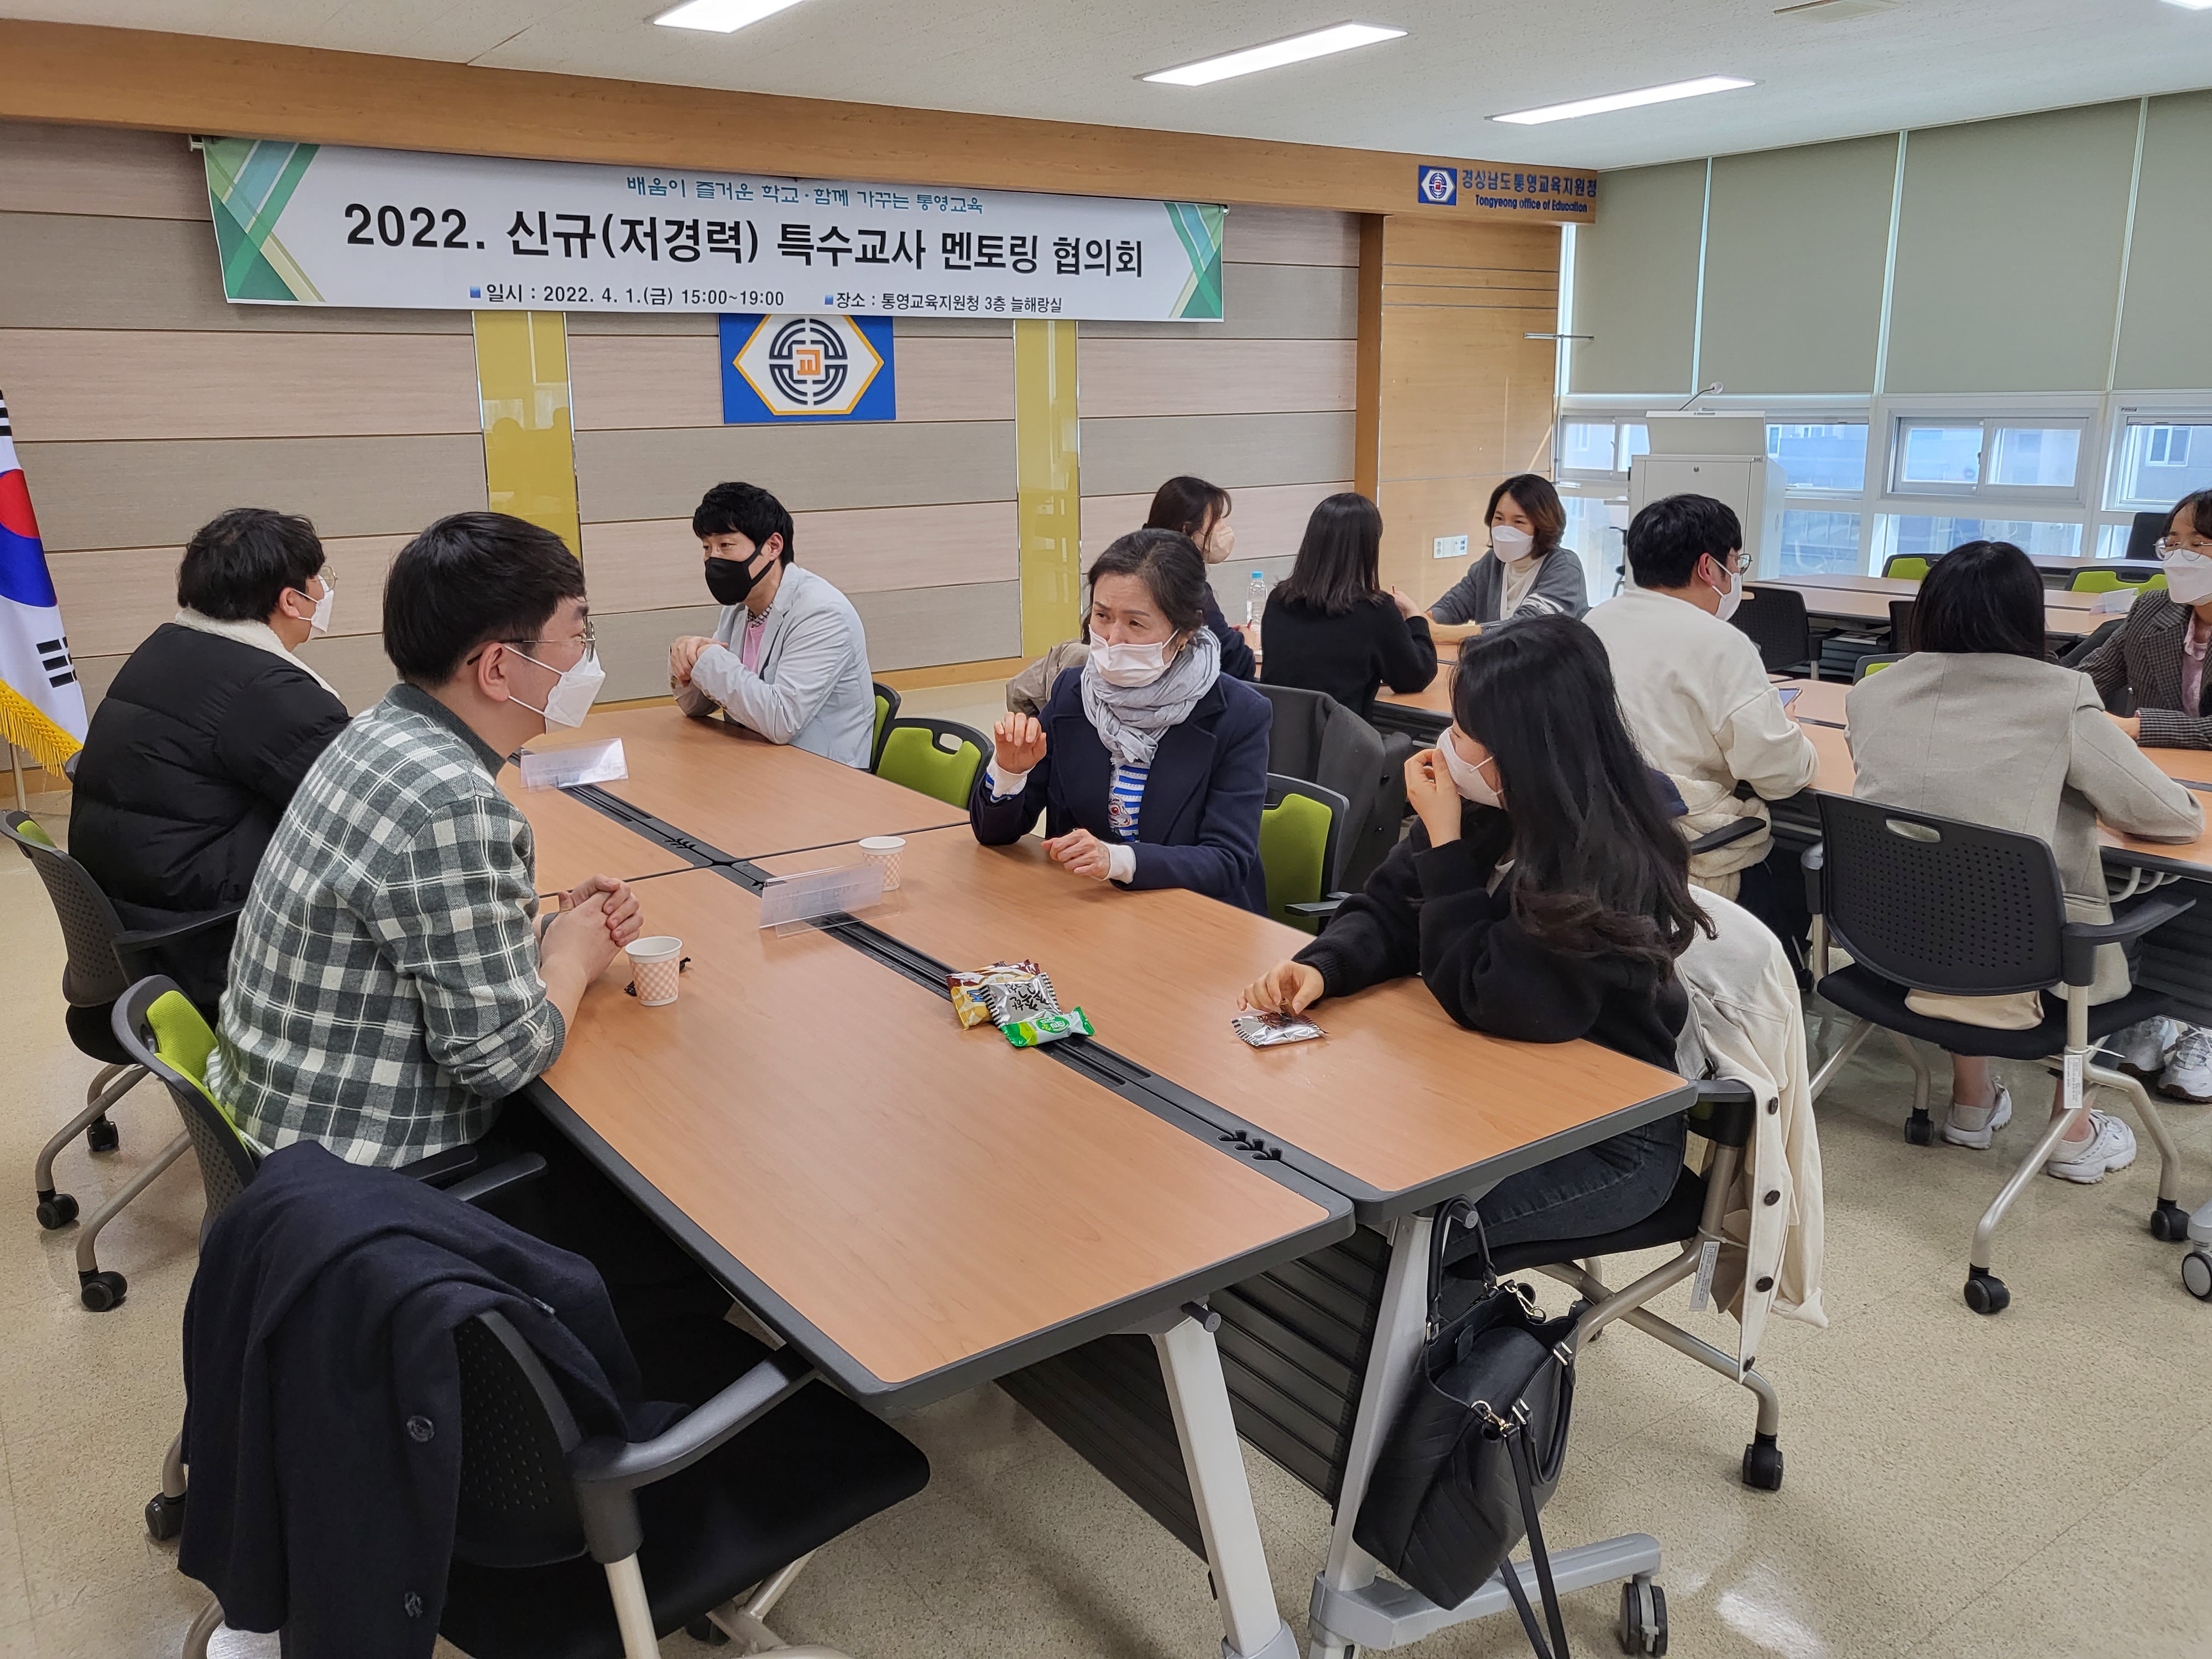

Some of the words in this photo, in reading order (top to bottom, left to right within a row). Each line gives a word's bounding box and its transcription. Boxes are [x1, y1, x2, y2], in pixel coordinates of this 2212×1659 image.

[627, 176, 686, 197] 배움이
[696, 180, 754, 201] 즐거운
[858, 190, 910, 210] 가꾸는
[916, 194, 983, 214] 통영교육
[1475, 195, 1517, 209] Tongyeong
[1543, 200, 1551, 210] of
[1552, 201, 1588, 212] Education
[345, 204, 485, 249] 2022.
[507, 210, 758, 264] 신규(저경력)
[778, 223, 926, 269] 특수교사
[941, 231, 1039, 274] 멘토링
[1053, 236, 1142, 278] 협의회
[487, 283, 523, 302] 일시
[544, 286, 594, 302] 2022.
[602, 288, 618, 303] 4.
[682, 289, 784, 306] 15:00~19:00
[836, 292, 865, 308] 장소
[881, 293, 979, 311] 통영교육지원청
[985, 296, 1006, 312] 3층
[1010, 296, 1062, 313] 늘해랑실
